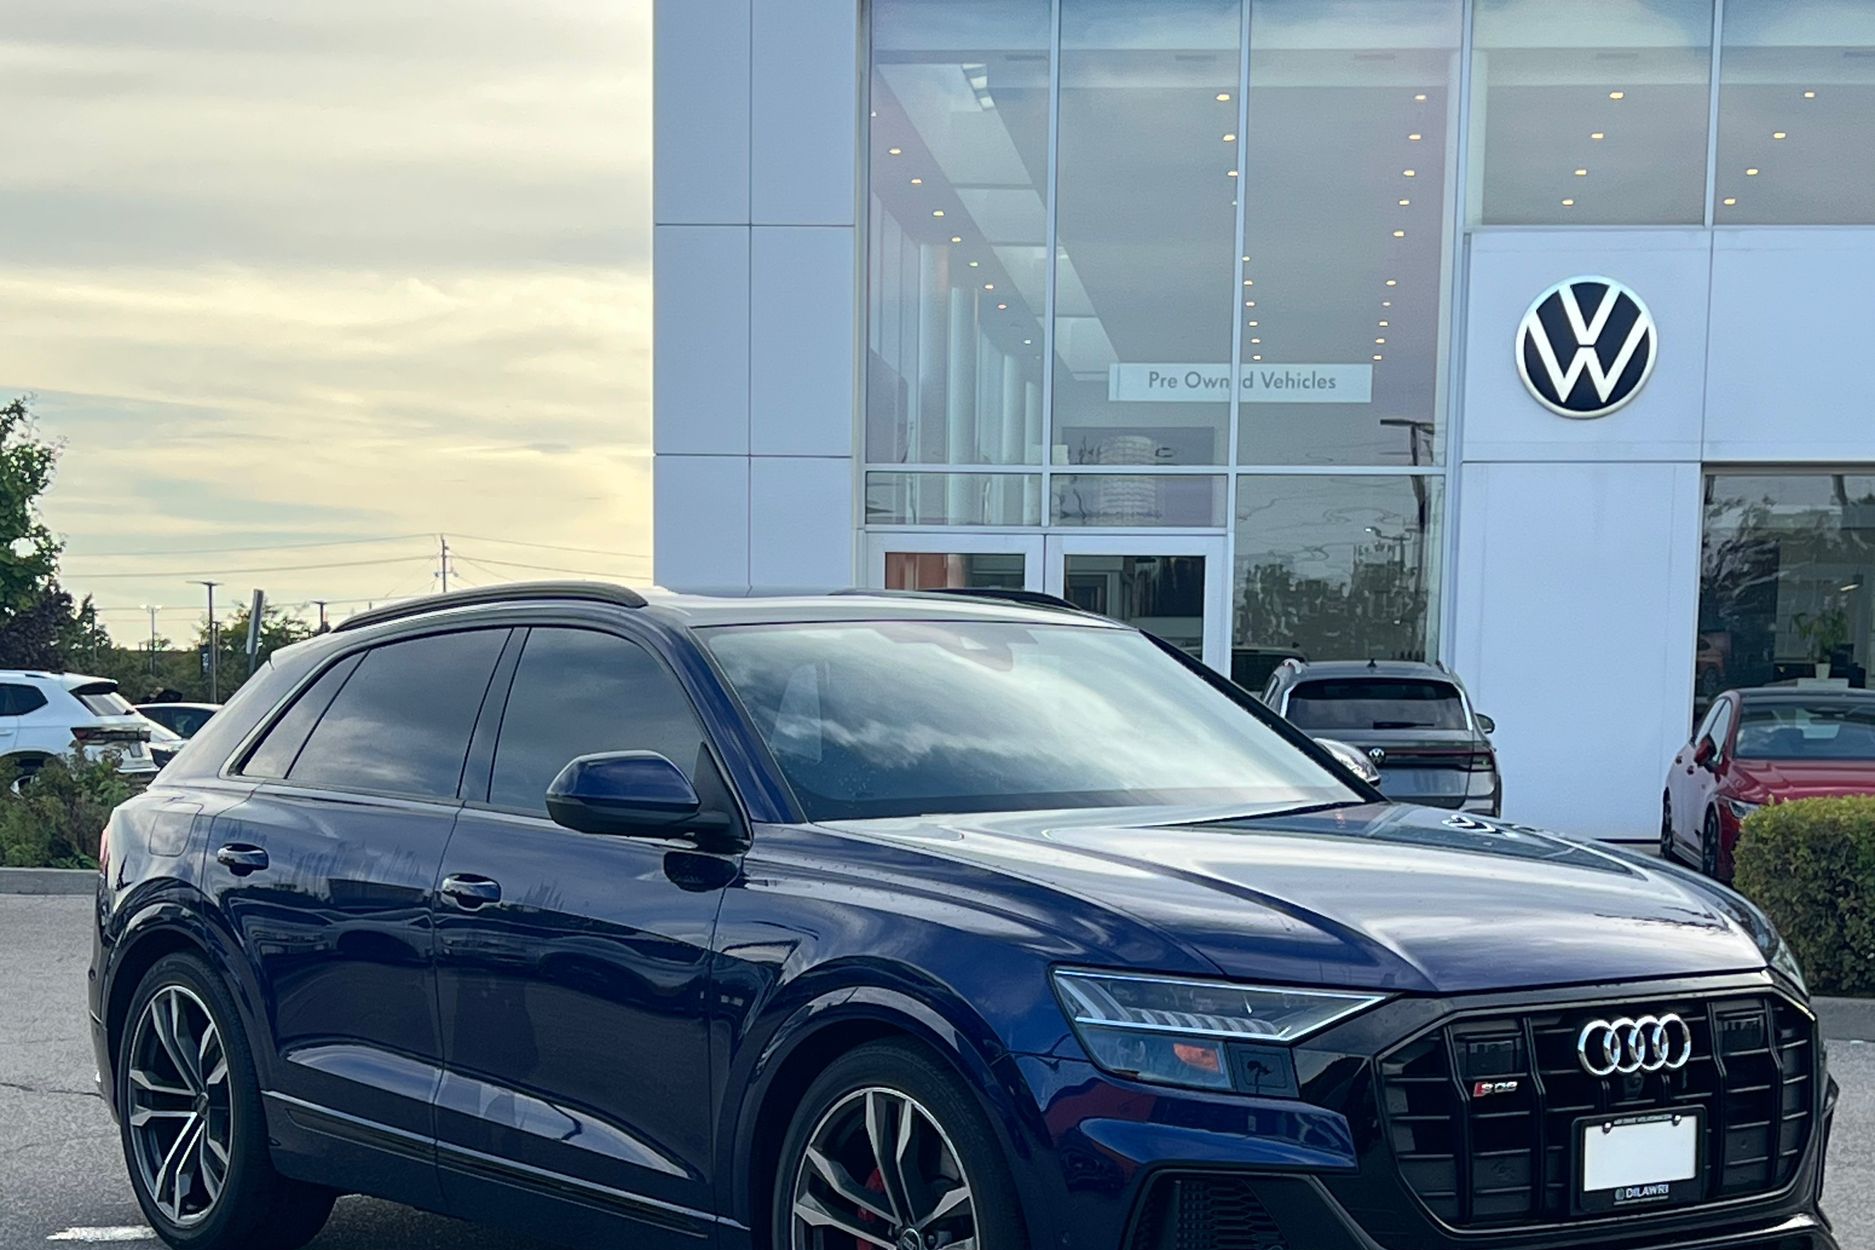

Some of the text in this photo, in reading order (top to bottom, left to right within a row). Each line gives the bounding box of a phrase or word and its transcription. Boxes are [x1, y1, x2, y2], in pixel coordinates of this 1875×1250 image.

[1148, 371, 1336, 389] Pre Ownd Vehicles
